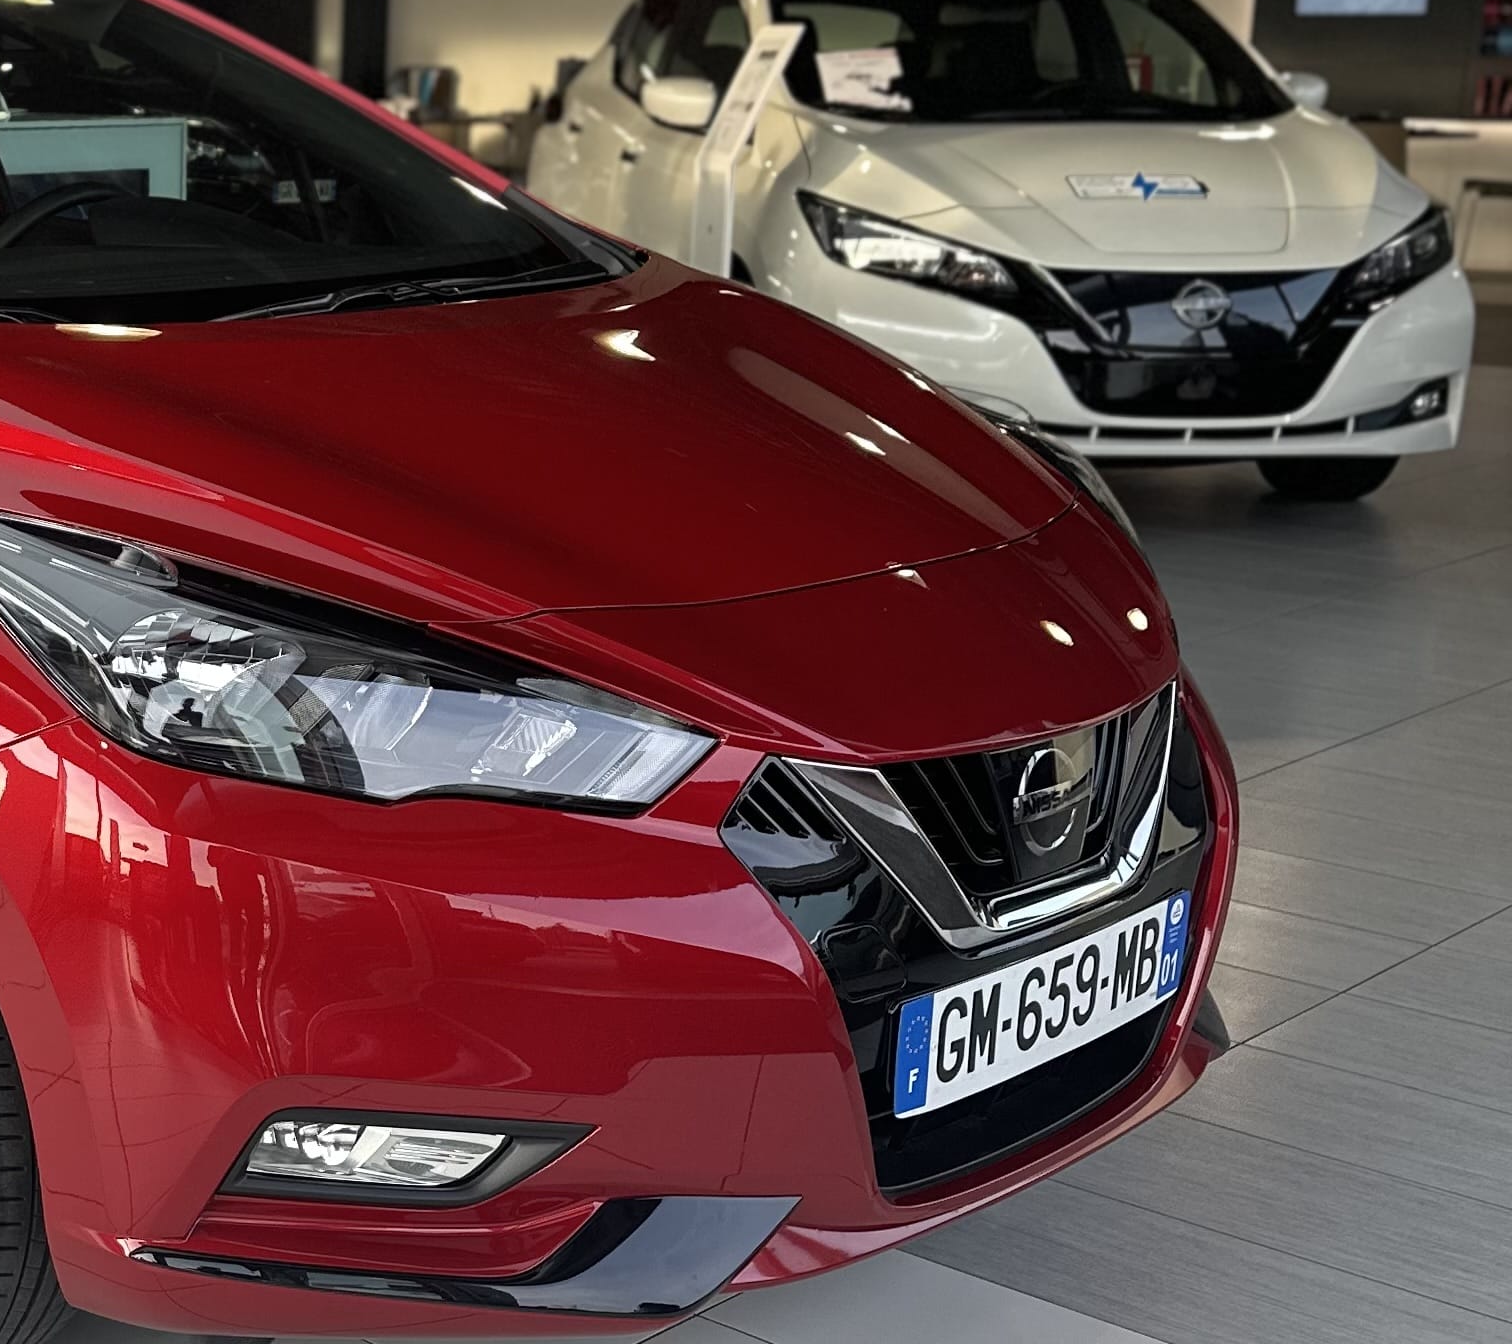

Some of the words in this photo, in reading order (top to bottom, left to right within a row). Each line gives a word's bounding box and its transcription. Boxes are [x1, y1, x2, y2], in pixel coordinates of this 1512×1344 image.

[1161, 948, 1179, 986] 01
[936, 916, 1160, 1083] GM-659-MB
[908, 1067, 919, 1094] F
